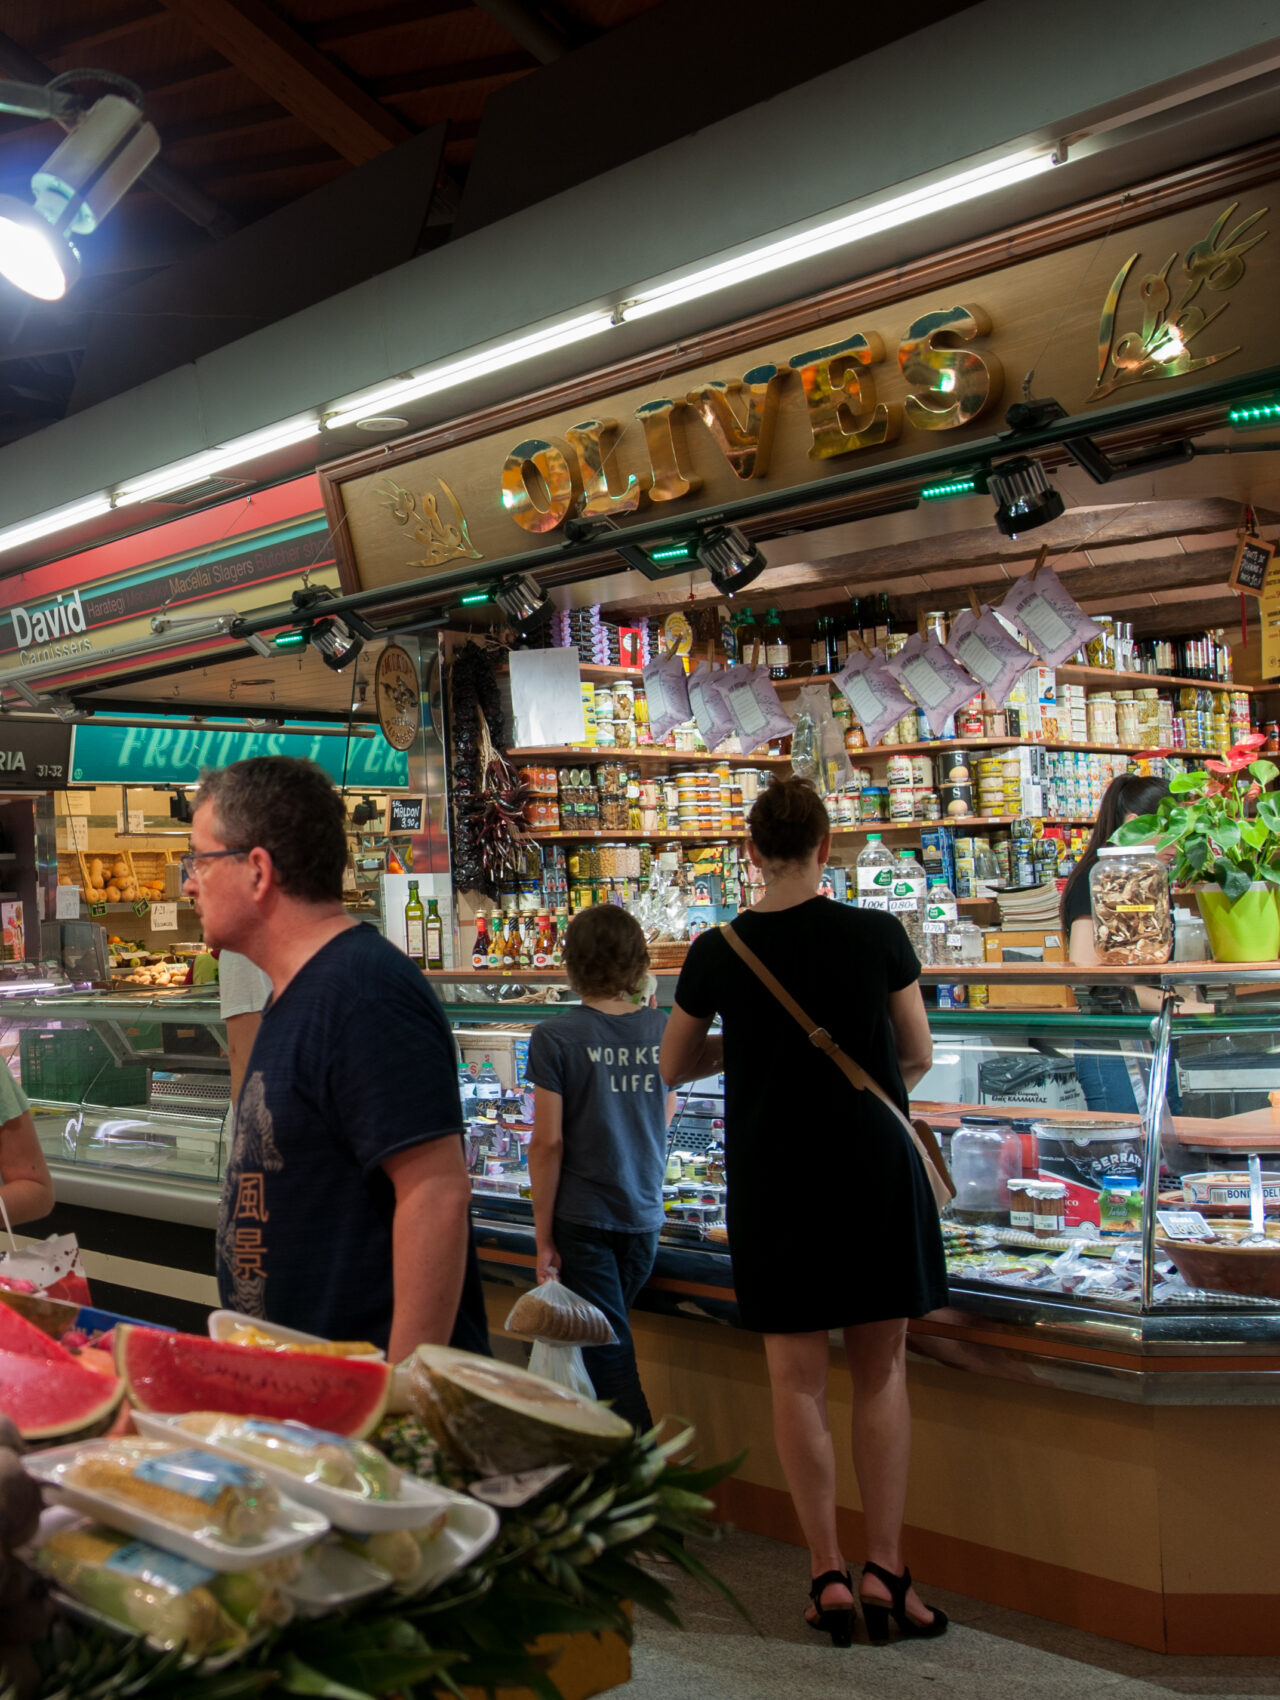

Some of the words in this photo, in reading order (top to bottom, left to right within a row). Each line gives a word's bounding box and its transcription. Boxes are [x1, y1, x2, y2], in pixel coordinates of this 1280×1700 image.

[501, 303, 1004, 532] OLIVES
[169, 569, 212, 596] Macellai
[11, 589, 87, 648] David
[37, 765, 62, 777] 31-32
[393, 806, 421, 819] MALDON
[586, 1045, 661, 1066] WORKE
[610, 1074, 655, 1092] LIFE
[232, 1172, 269, 1280] 風景
